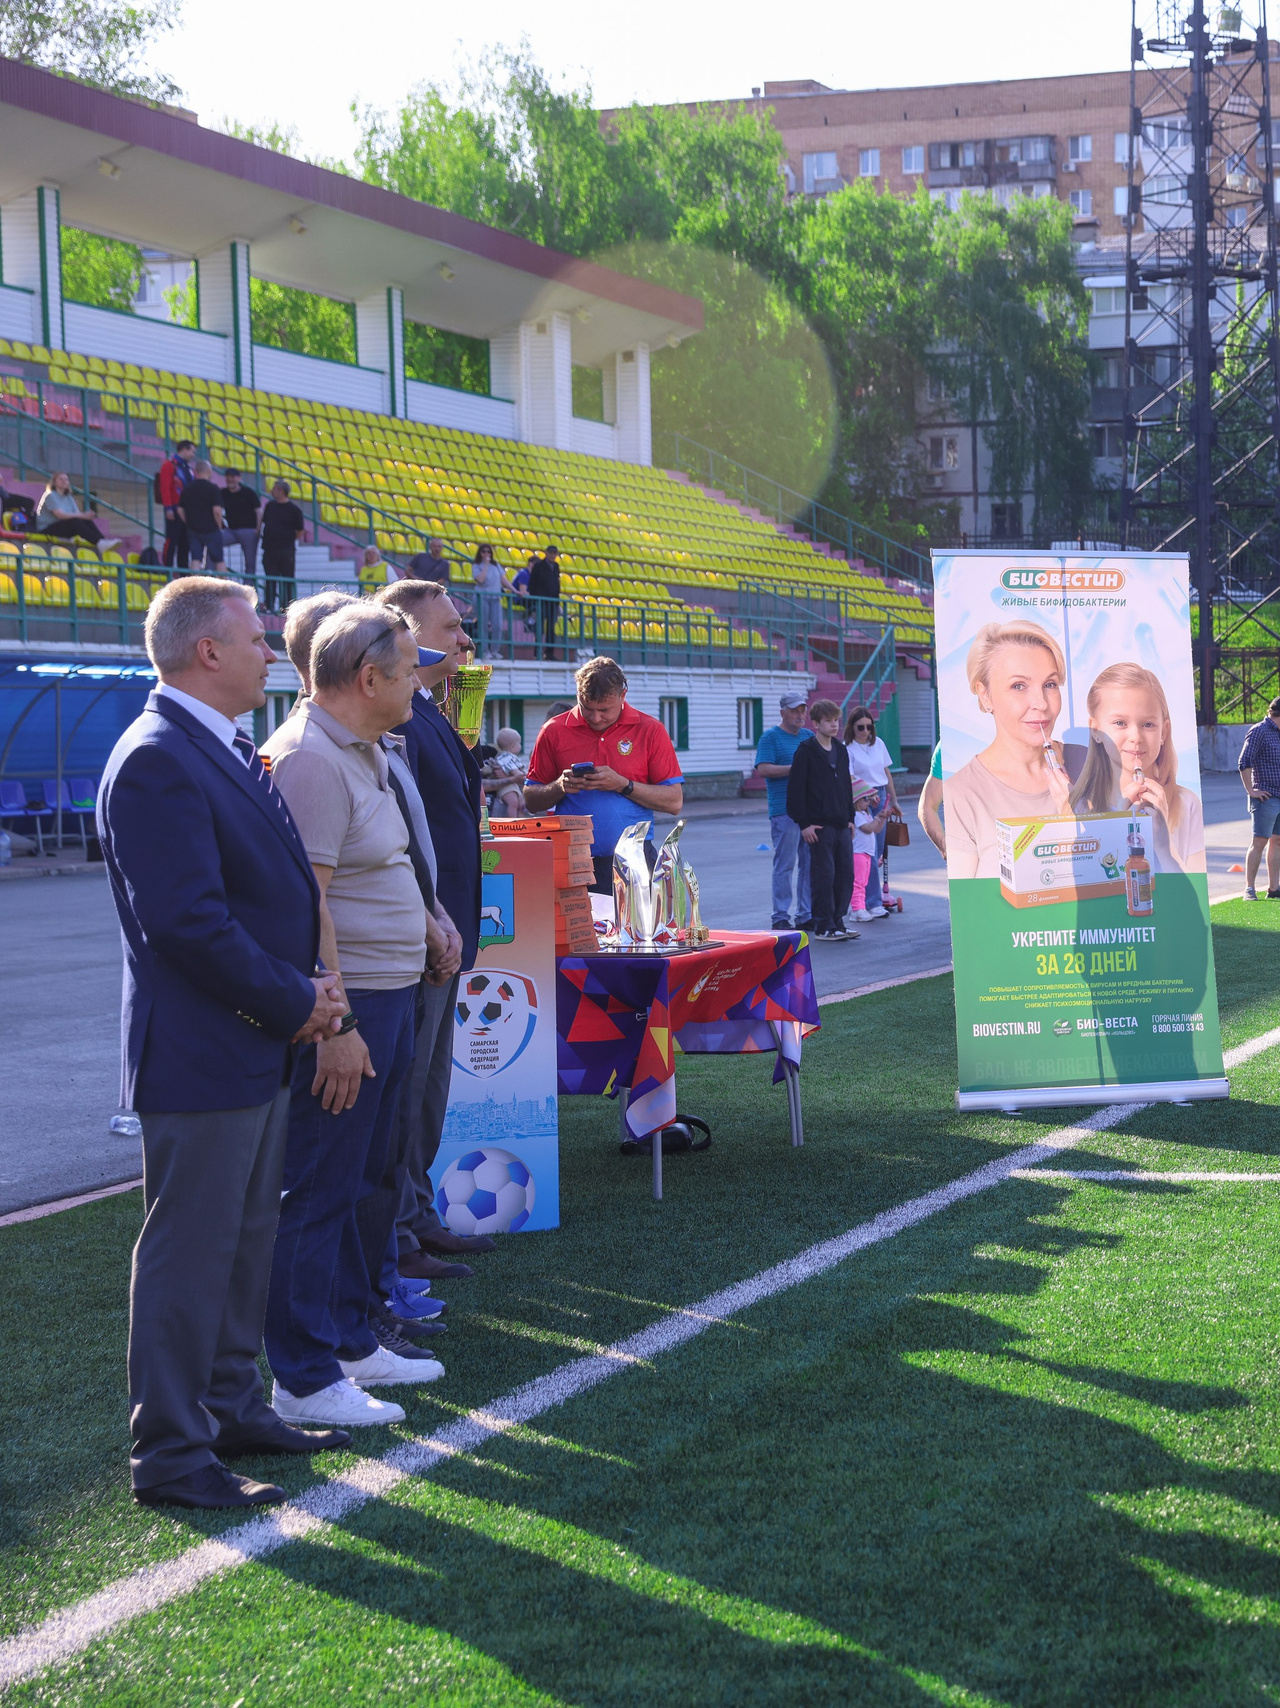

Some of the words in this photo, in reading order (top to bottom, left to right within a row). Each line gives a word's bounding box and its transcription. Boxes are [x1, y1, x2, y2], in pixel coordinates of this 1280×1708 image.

[1009, 572, 1118, 587] БИОВЕСТИН
[1001, 597, 1038, 606] ЖИВЫЕ
[1040, 597, 1127, 608] БИФИДОБАКТЕРИИ
[1037, 842, 1097, 856] БИОВЕСТИН
[1027, 894, 1038, 903] 28
[1011, 929, 1077, 948] УКРЕПИТЕ
[1079, 926, 1156, 945] ИММУНИТЕТ
[1036, 953, 1060, 976] ЗА
[1063, 952, 1086, 974] 28
[1089, 946, 1138, 976] ДНЕЙ
[989, 985, 1023, 993] ПОВЫШАЕТ
[1023, 983, 1085, 991] СОПРОТИВЛЯЕМОСТЬ
[1122, 980, 1151, 988] ВРЕДНЫМ
[979, 994, 1010, 1002] ПОМОГАЕТ
[1010, 993, 1038, 1001] БЫСТРЕЕ
[1039, 991, 1092, 1000] АДАПТИРОВАТЬСЯ
[1097, 989, 1117, 997] НОВОЙ
[1024, 1001, 1052, 1009] СНИЖАЕТ
[1053, 998, 1124, 1007] ПСИХОЭМОЦИОНАЛЬНУЮ
[1076, 1016, 1139, 1030] БИО-ВЕСТА
[1151, 1013, 1180, 1023] ГОРЯЧАЯ
[1181, 1013, 1204, 1022] ЛИНИЯ
[972, 1021, 1041, 1037] BIOVESTIN.RU
[1152, 1024, 1157, 1033] 8
[1158, 1023, 1171, 1033] 800
[1172, 1023, 1185, 1032] 500
[1186, 1022, 1195, 1032] 33
[1195, 1022, 1204, 1031] 43
[975, 1060, 1010, 1081] БАД.
[1014, 1059, 1033, 1078] НЕ
[1036, 1055, 1112, 1077] ЯВЛЯЕТСЯ
[1116, 1050, 1209, 1072] ЛЕКАРСТВОМ
